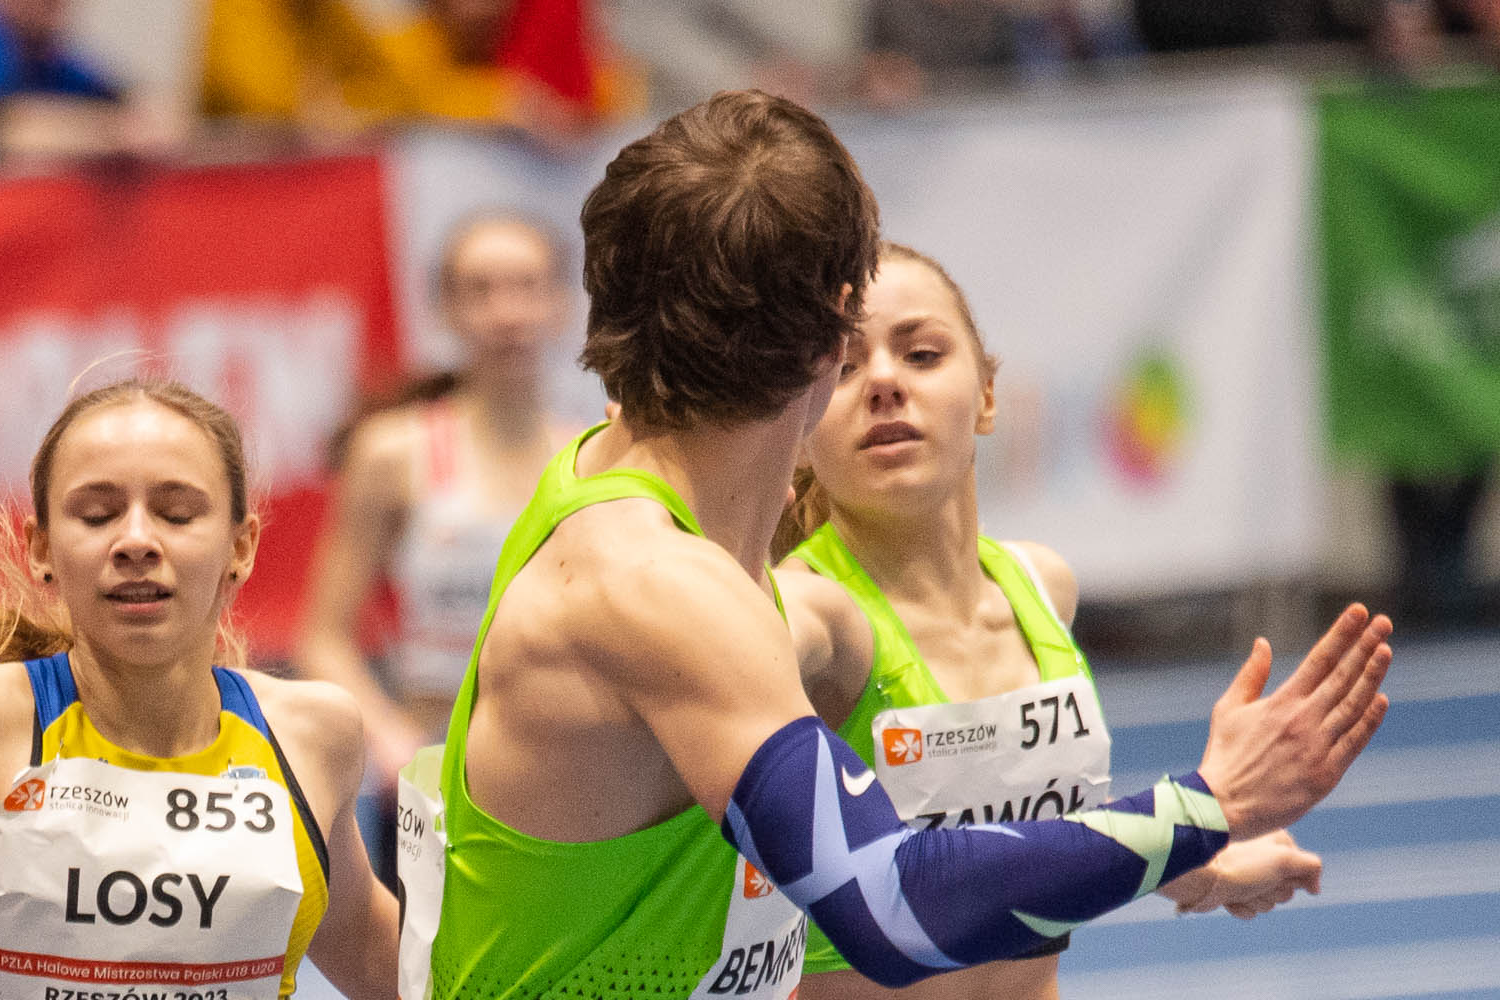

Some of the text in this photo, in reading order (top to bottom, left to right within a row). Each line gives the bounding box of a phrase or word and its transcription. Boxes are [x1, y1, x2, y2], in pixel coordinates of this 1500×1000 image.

[926, 724, 996, 747] rzeszów
[1020, 691, 1089, 750] 571
[50, 785, 129, 808] rzeszów
[165, 788, 276, 833] 853
[65, 867, 231, 929] LOSY
[0, 955, 277, 982] PZLA Halowe Mistrzostwa Polski U18 U20
